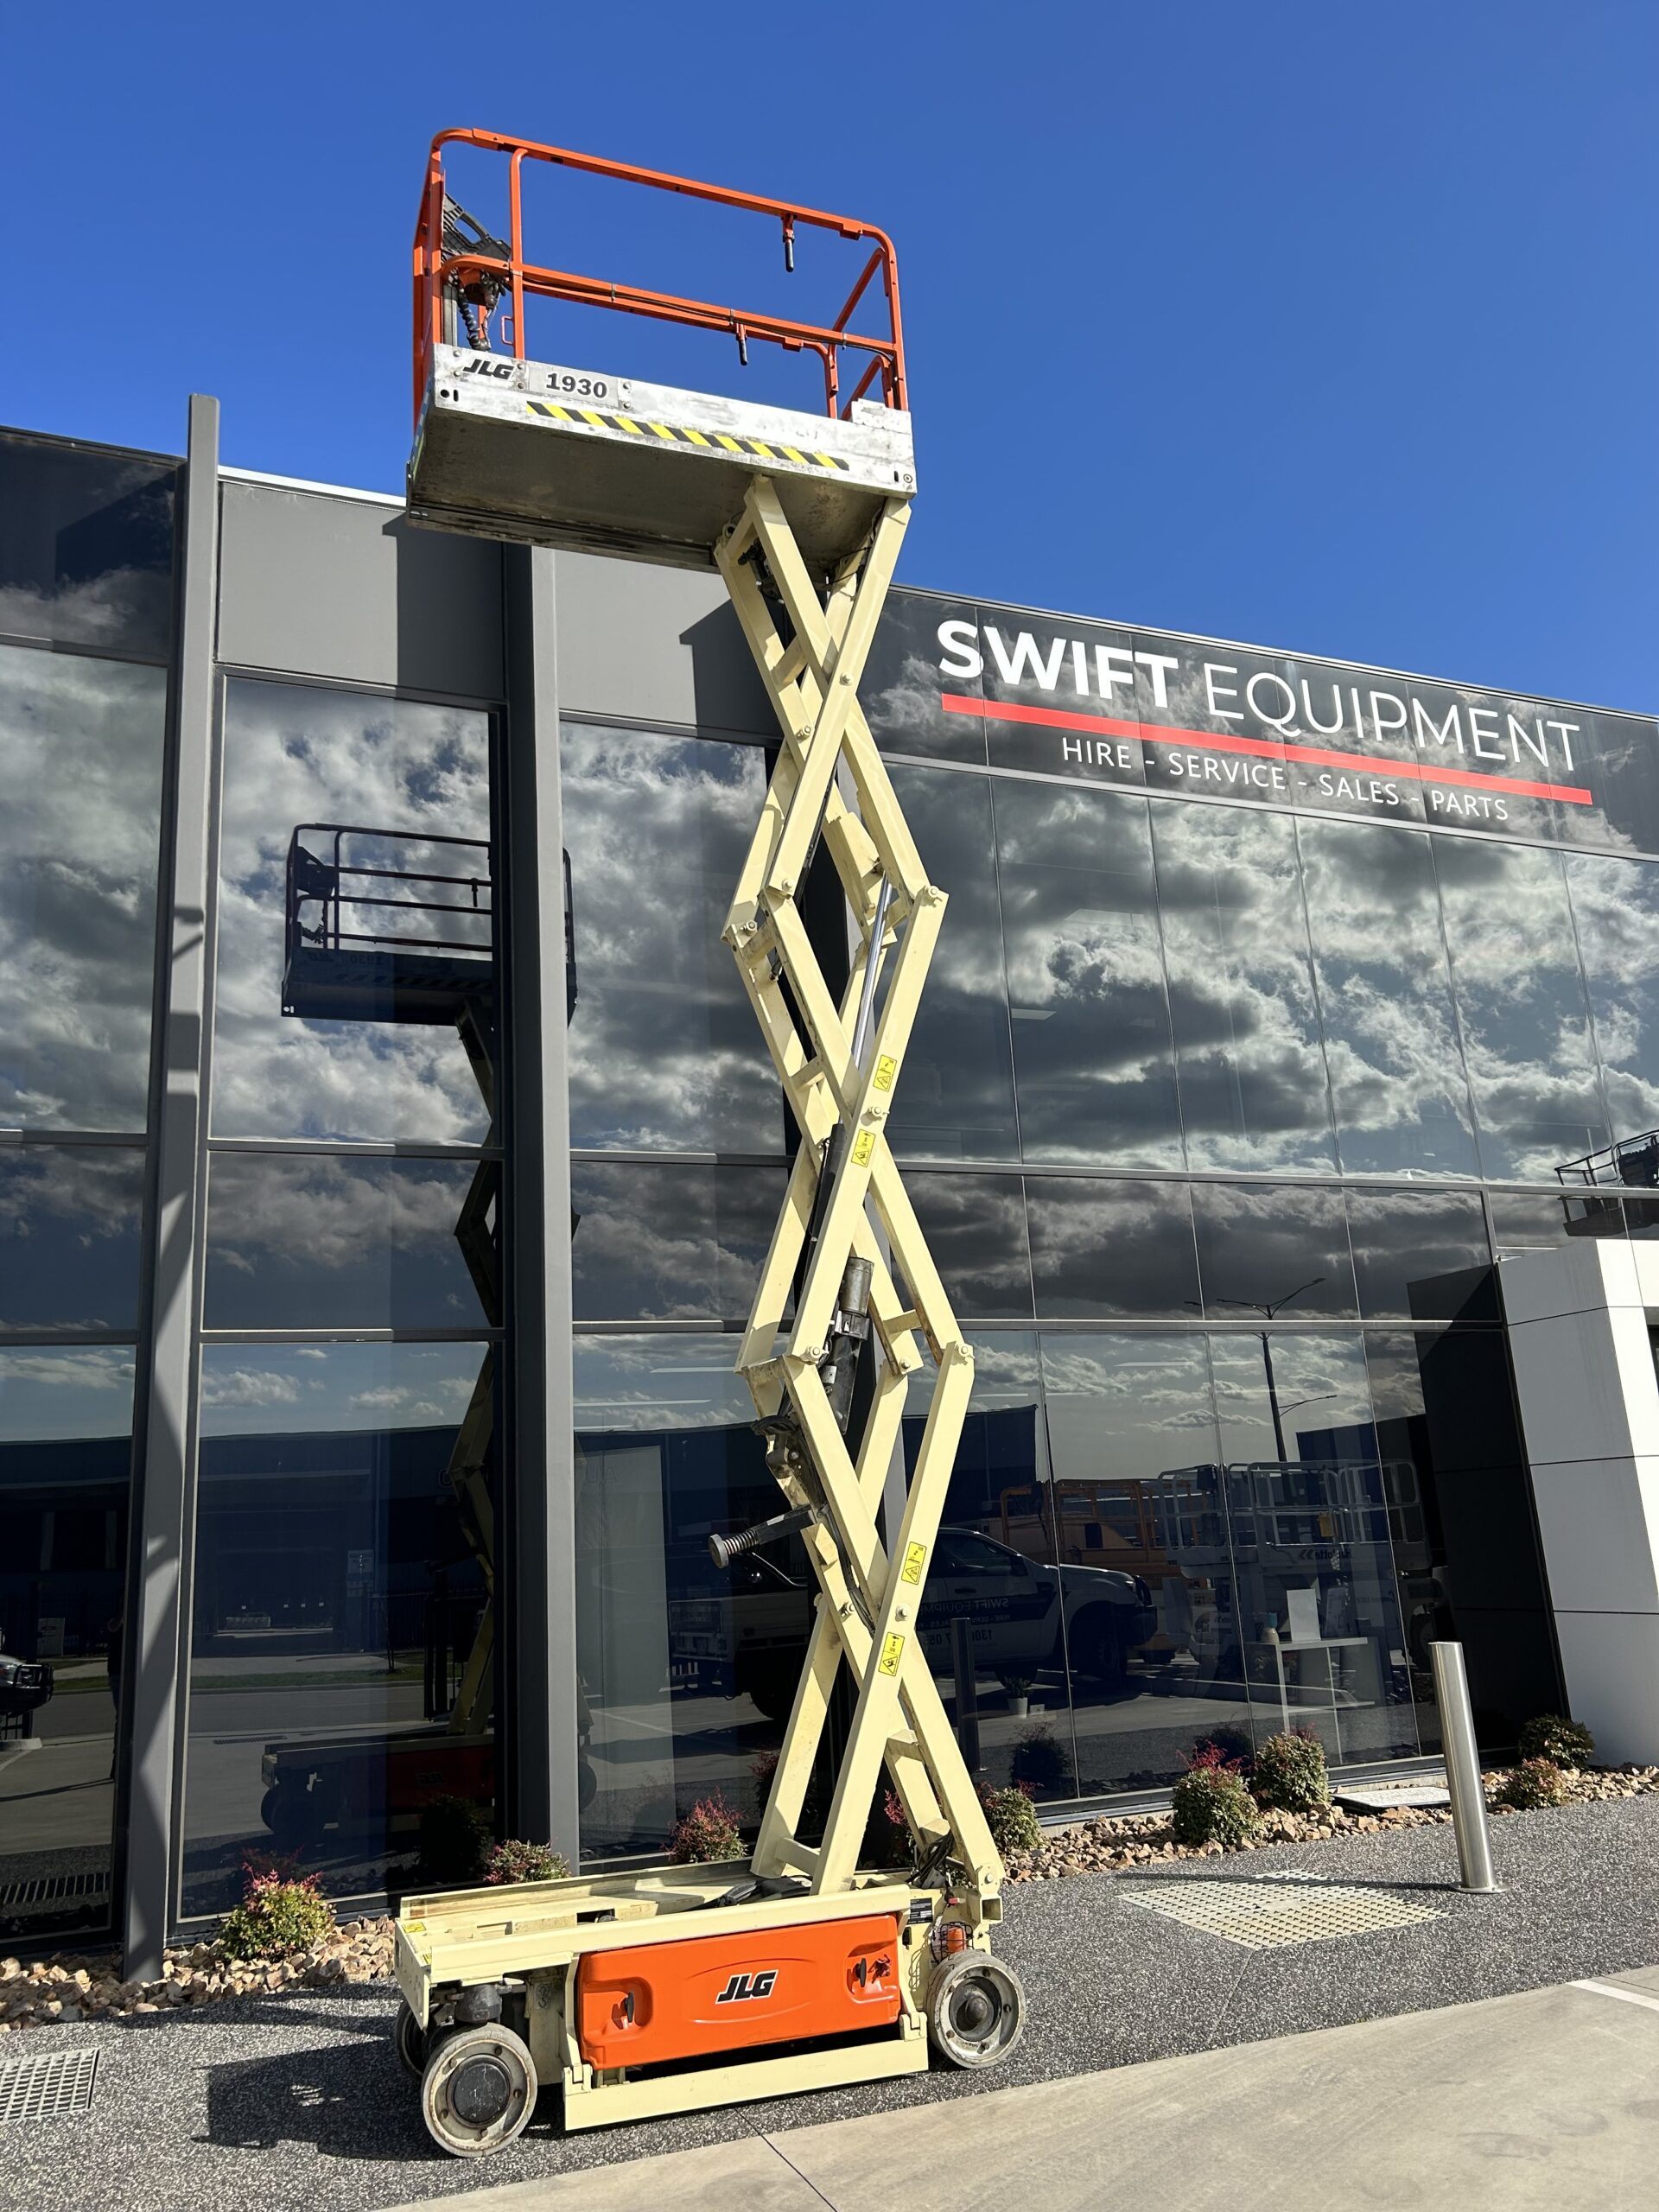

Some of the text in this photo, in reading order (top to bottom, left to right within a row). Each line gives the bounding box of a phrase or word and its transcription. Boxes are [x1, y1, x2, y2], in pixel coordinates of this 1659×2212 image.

[463, 359, 514, 380] JLG
[546, 372, 607, 398] 1930
[938, 620, 1580, 772] SWIFT EQUIPMENT
[1062, 737, 1132, 769] HIRE
[1168, 753, 1286, 790] SERVICE
[1319, 774, 1400, 805] SALES
[1431, 790, 1509, 821] PARTS
[715, 1969, 779, 2005] JLG
